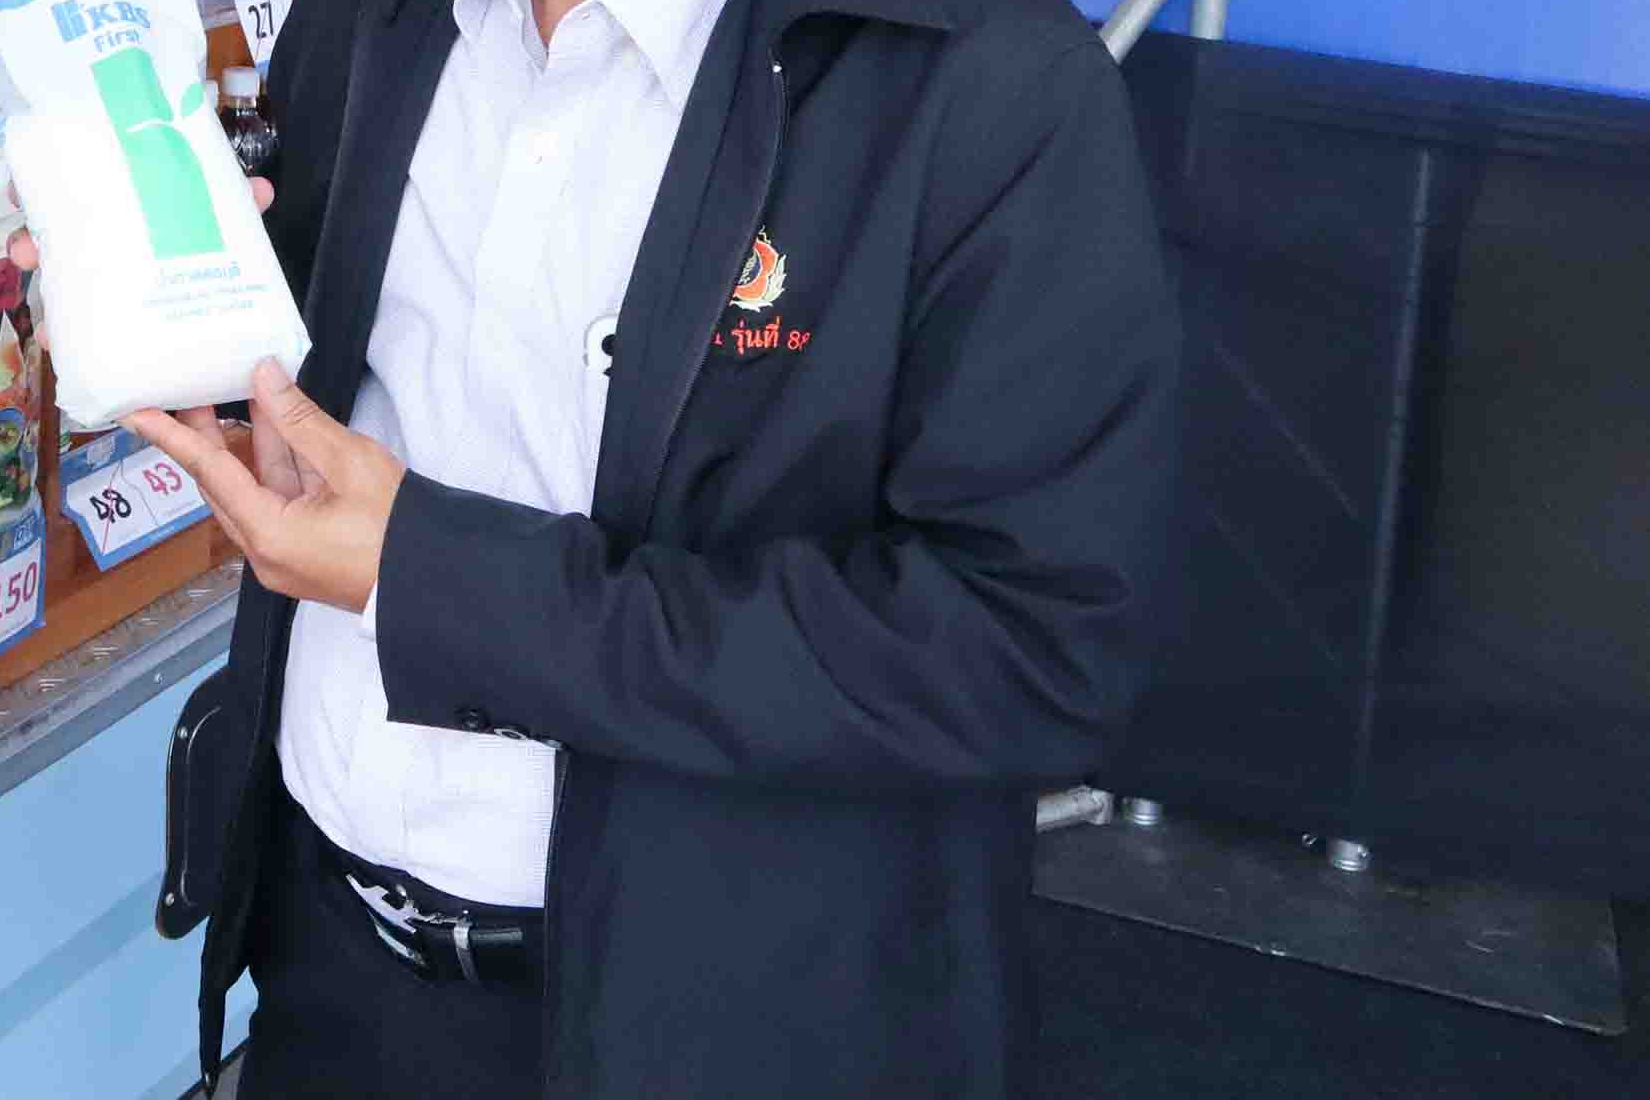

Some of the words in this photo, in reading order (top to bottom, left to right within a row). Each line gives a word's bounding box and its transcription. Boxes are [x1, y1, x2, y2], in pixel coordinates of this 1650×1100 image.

[247, 0, 275, 40] 27
[731, 316, 781, 356] รุ่นที่
[89, 489, 133, 524] 48
[142, 462, 184, 496] 43
